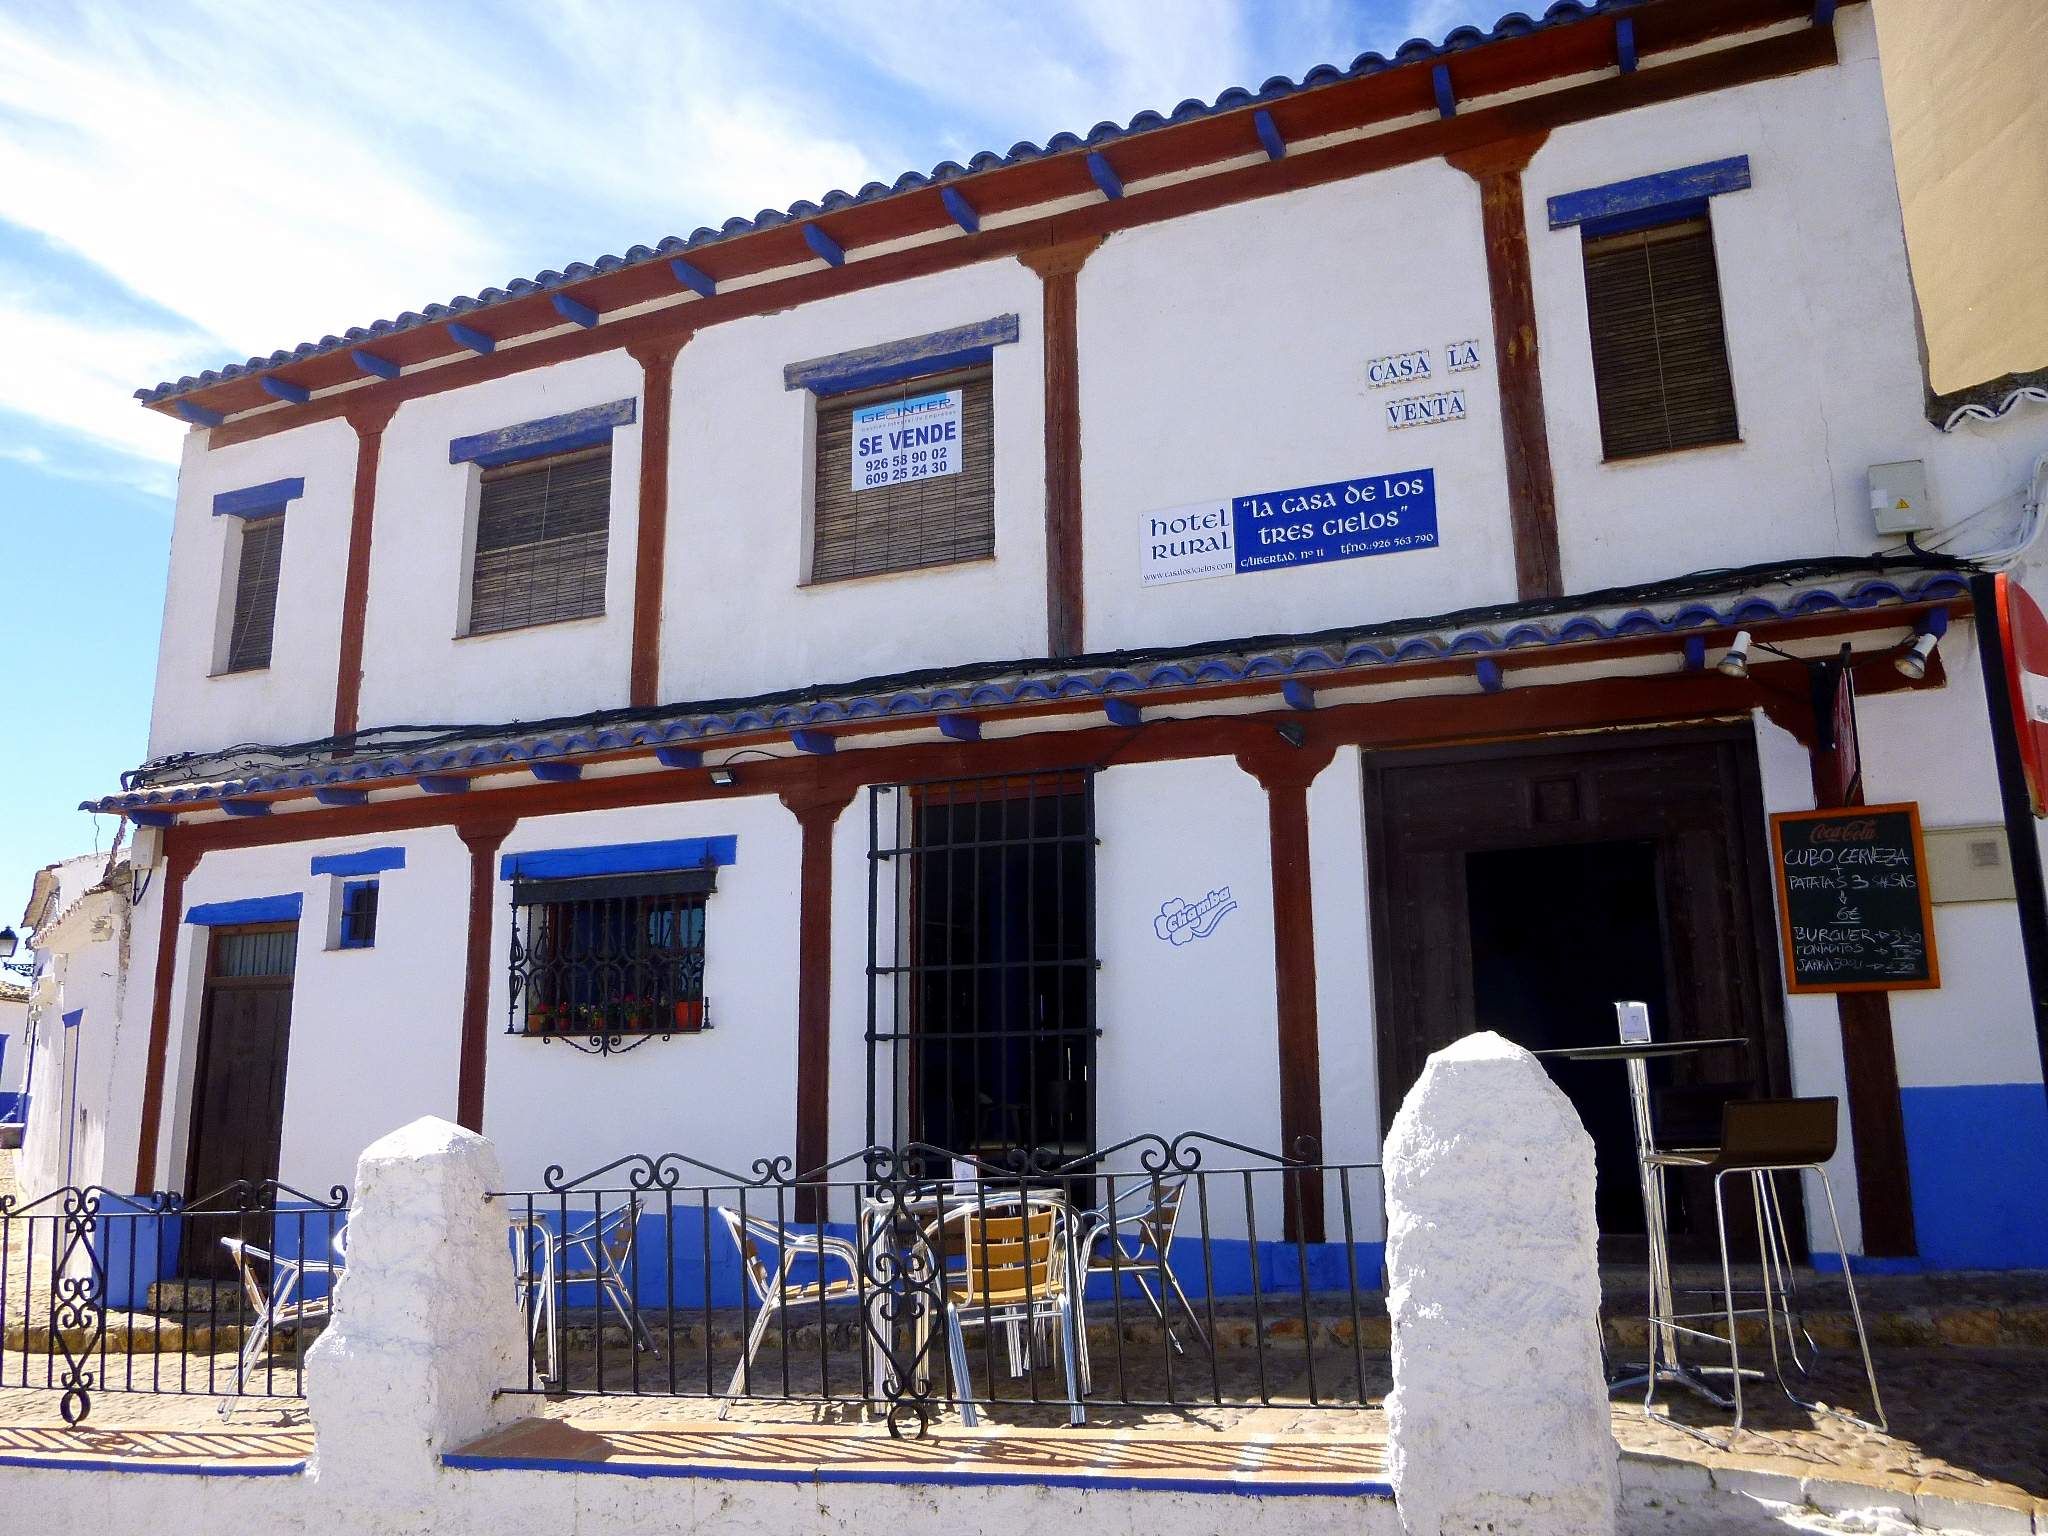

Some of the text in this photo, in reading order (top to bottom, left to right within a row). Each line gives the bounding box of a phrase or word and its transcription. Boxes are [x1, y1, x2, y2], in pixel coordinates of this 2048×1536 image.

[1369, 346, 1480, 382] CASA LA
[1387, 396, 1465, 423] VENTA
[859, 421, 957, 457] SE VENDE
[866, 447, 947, 472] 926 58 90 02
[866, 461, 947, 485] 609 25 24 30
[1394, 537, 1412, 547] 563
[1415, 533, 1434, 544] 790
[1784, 845, 1909, 867] CUBO CERVEZA
[1788, 875, 1848, 890] PATATAS
[1851, 874, 1869, 889] 3
[1793, 926, 1876, 943] BURGUER
